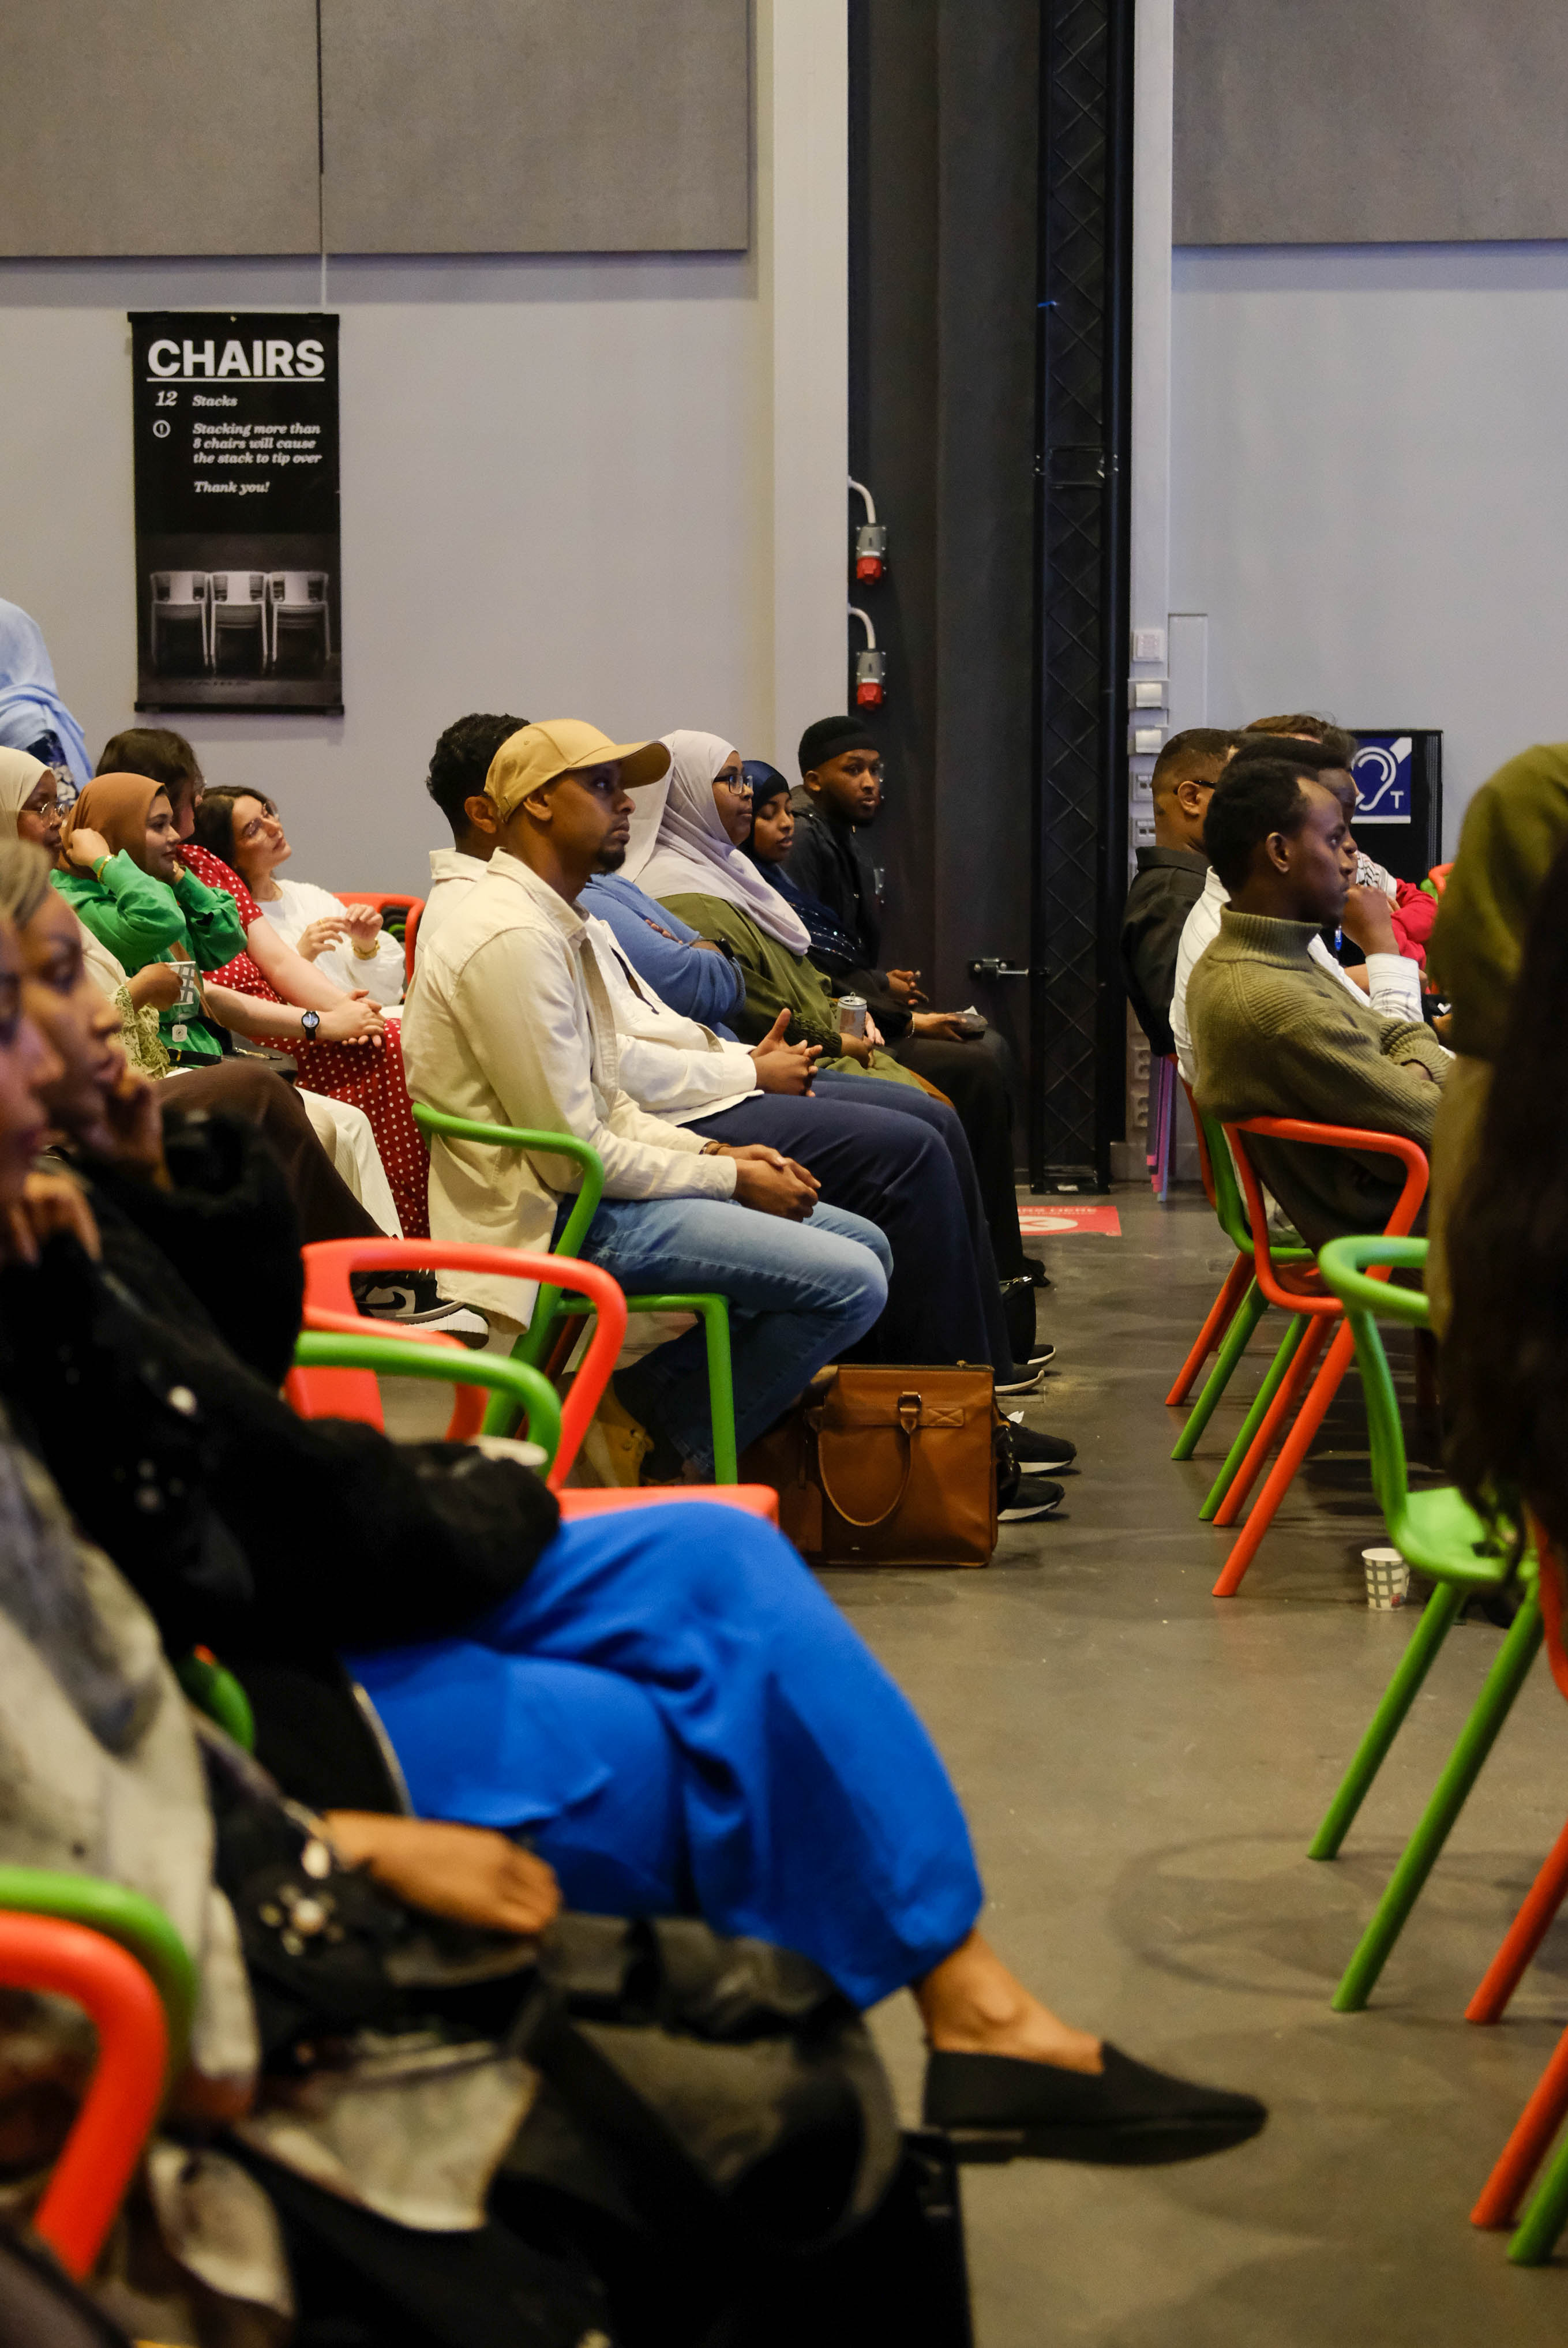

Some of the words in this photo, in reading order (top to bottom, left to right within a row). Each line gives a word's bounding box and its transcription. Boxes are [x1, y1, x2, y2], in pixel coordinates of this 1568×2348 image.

[148, 339, 324, 377] CHAIRS
[156, 391, 178, 406] 12
[192, 395, 238, 406] Stacks
[193, 423, 252, 437] Stacking
[253, 426, 287, 434] more
[290, 423, 320, 434] than
[193, 437, 201, 448] 8
[204, 437, 246, 449] chairs
[249, 437, 273, 448] will
[276, 440, 316, 448] cause
[194, 452, 215, 463] the
[217, 452, 254, 463] stack
[256, 453, 269, 463] to
[272, 452, 290, 466] tip
[292, 455, 322, 463] over
[194, 481, 237, 493] Thank
[239, 481, 270, 496] you!
[1390, 790, 1404, 809] T
